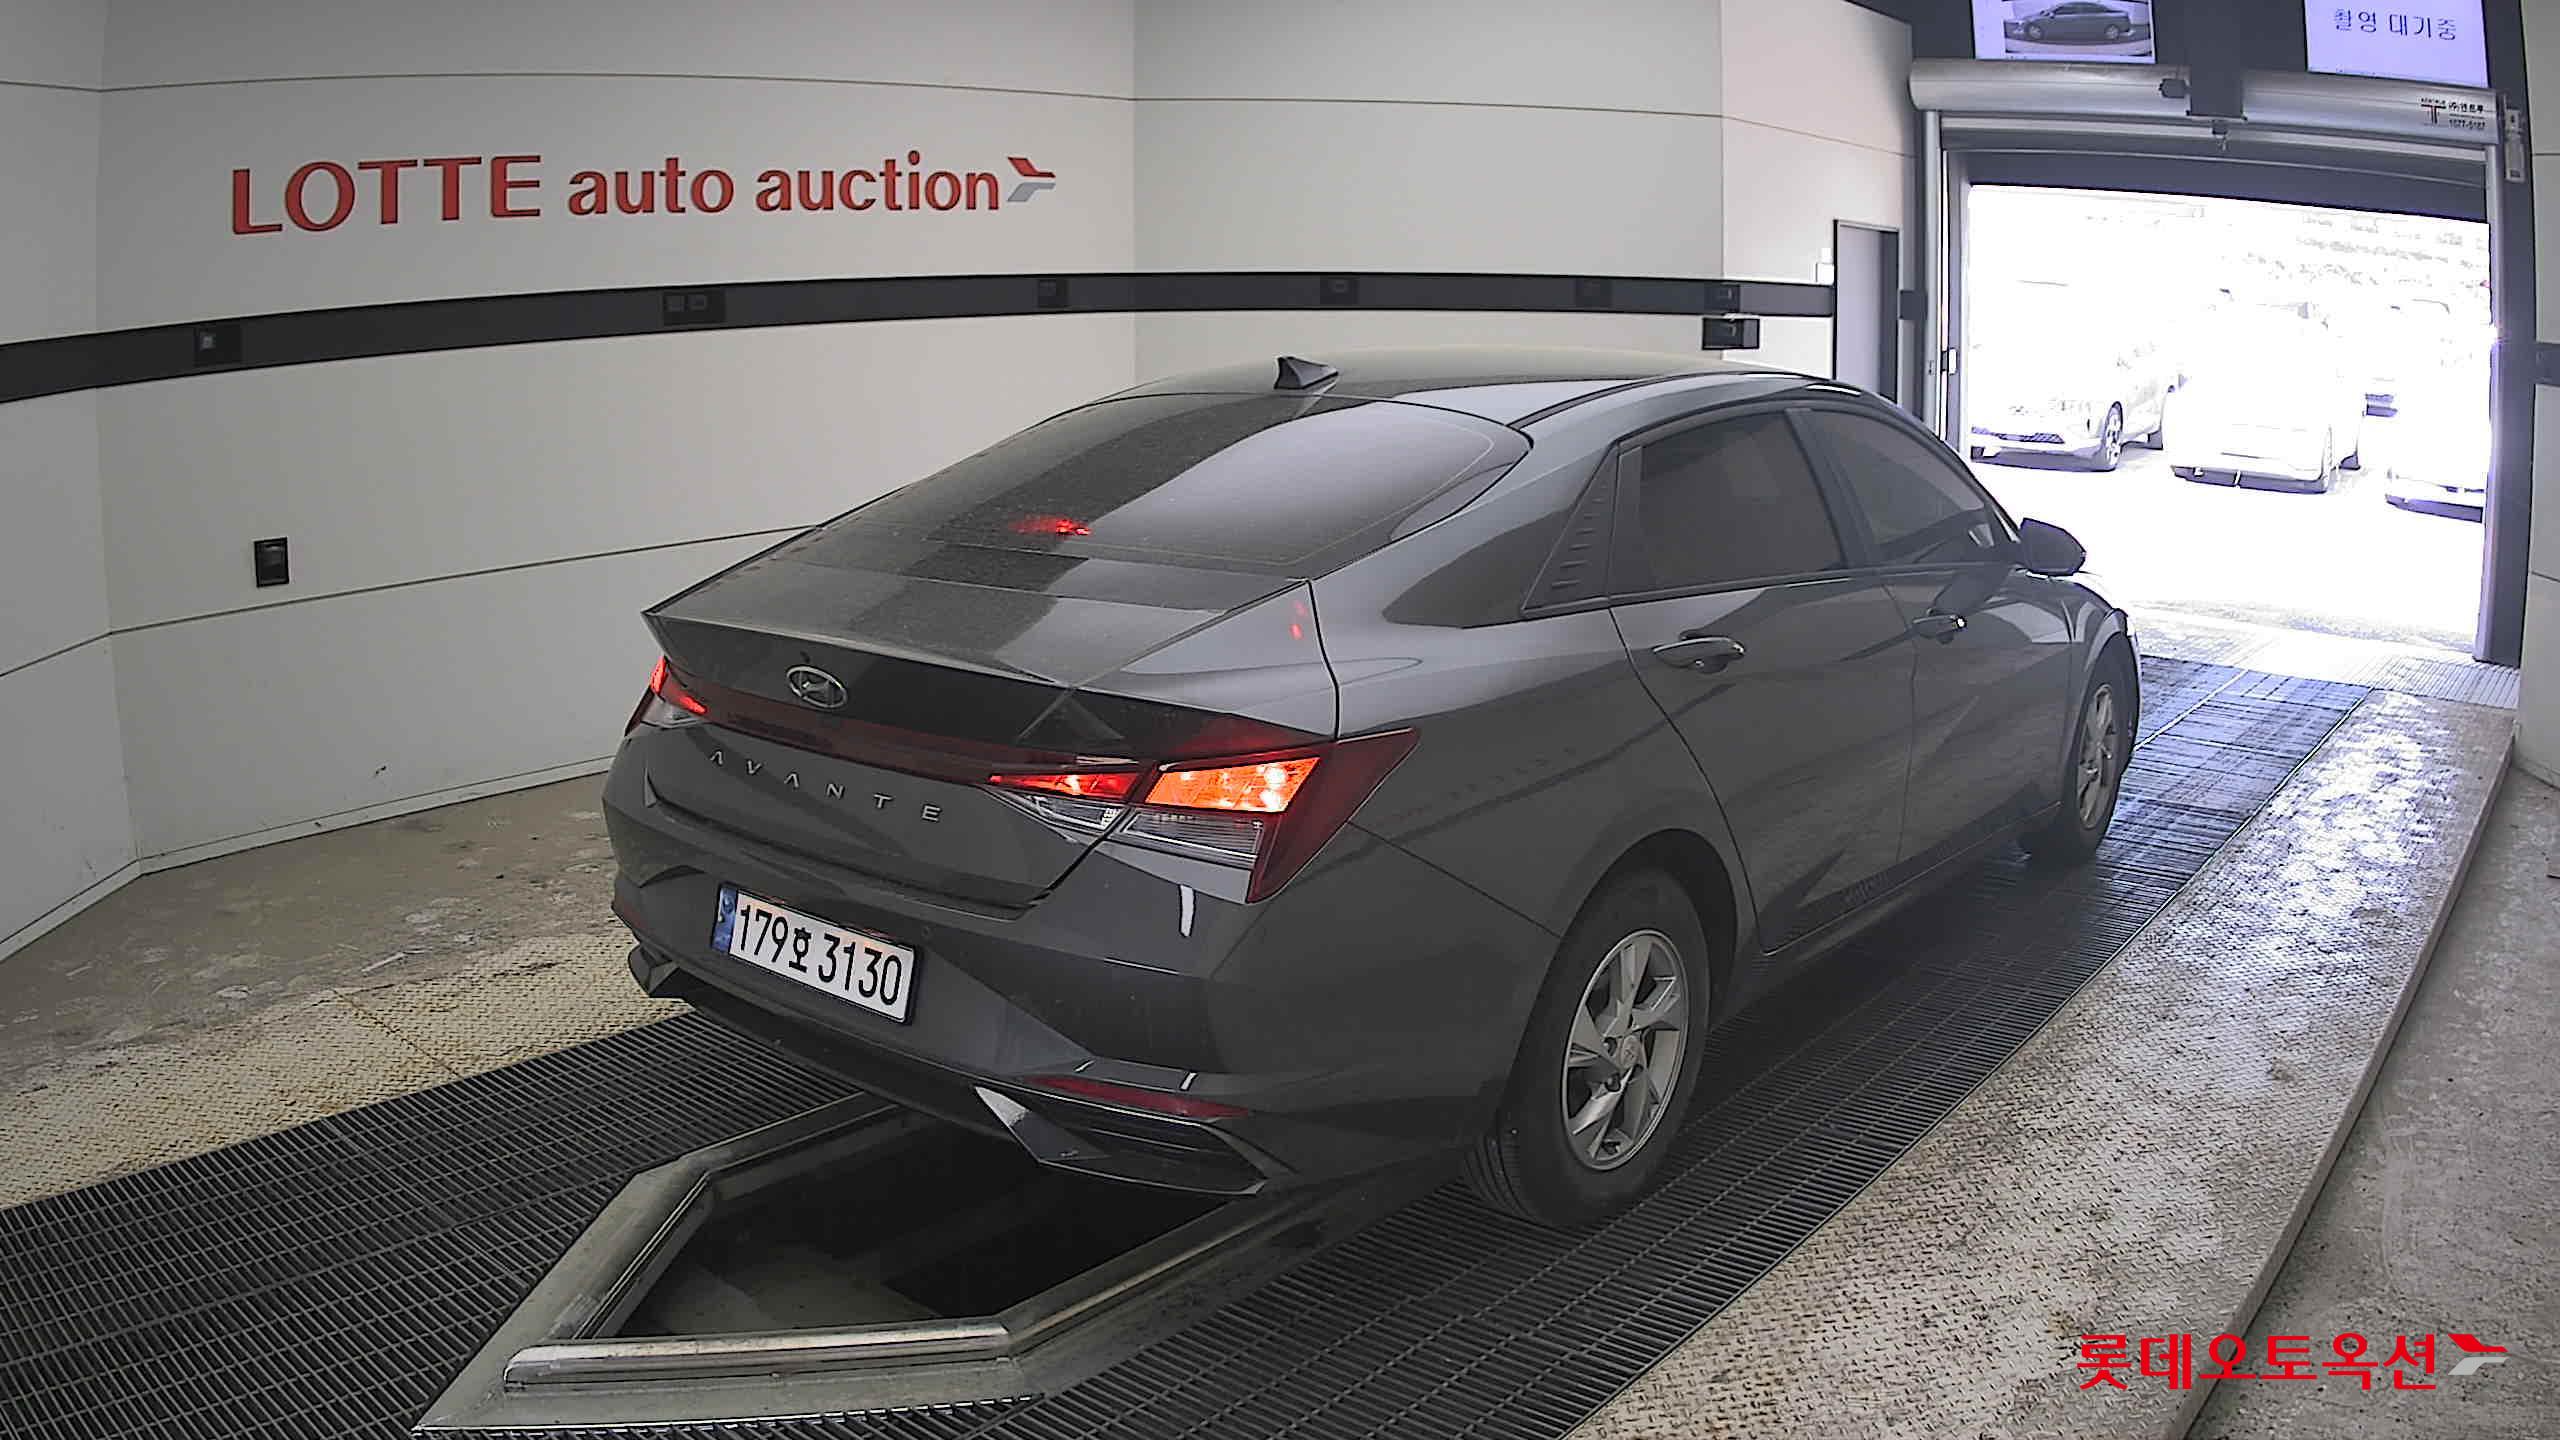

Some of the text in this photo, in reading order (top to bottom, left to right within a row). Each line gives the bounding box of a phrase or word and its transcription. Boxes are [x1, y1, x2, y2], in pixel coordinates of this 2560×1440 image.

[233, 150, 1000, 235] LOTTE auto auction
[710, 751, 941, 822] AVANTE
